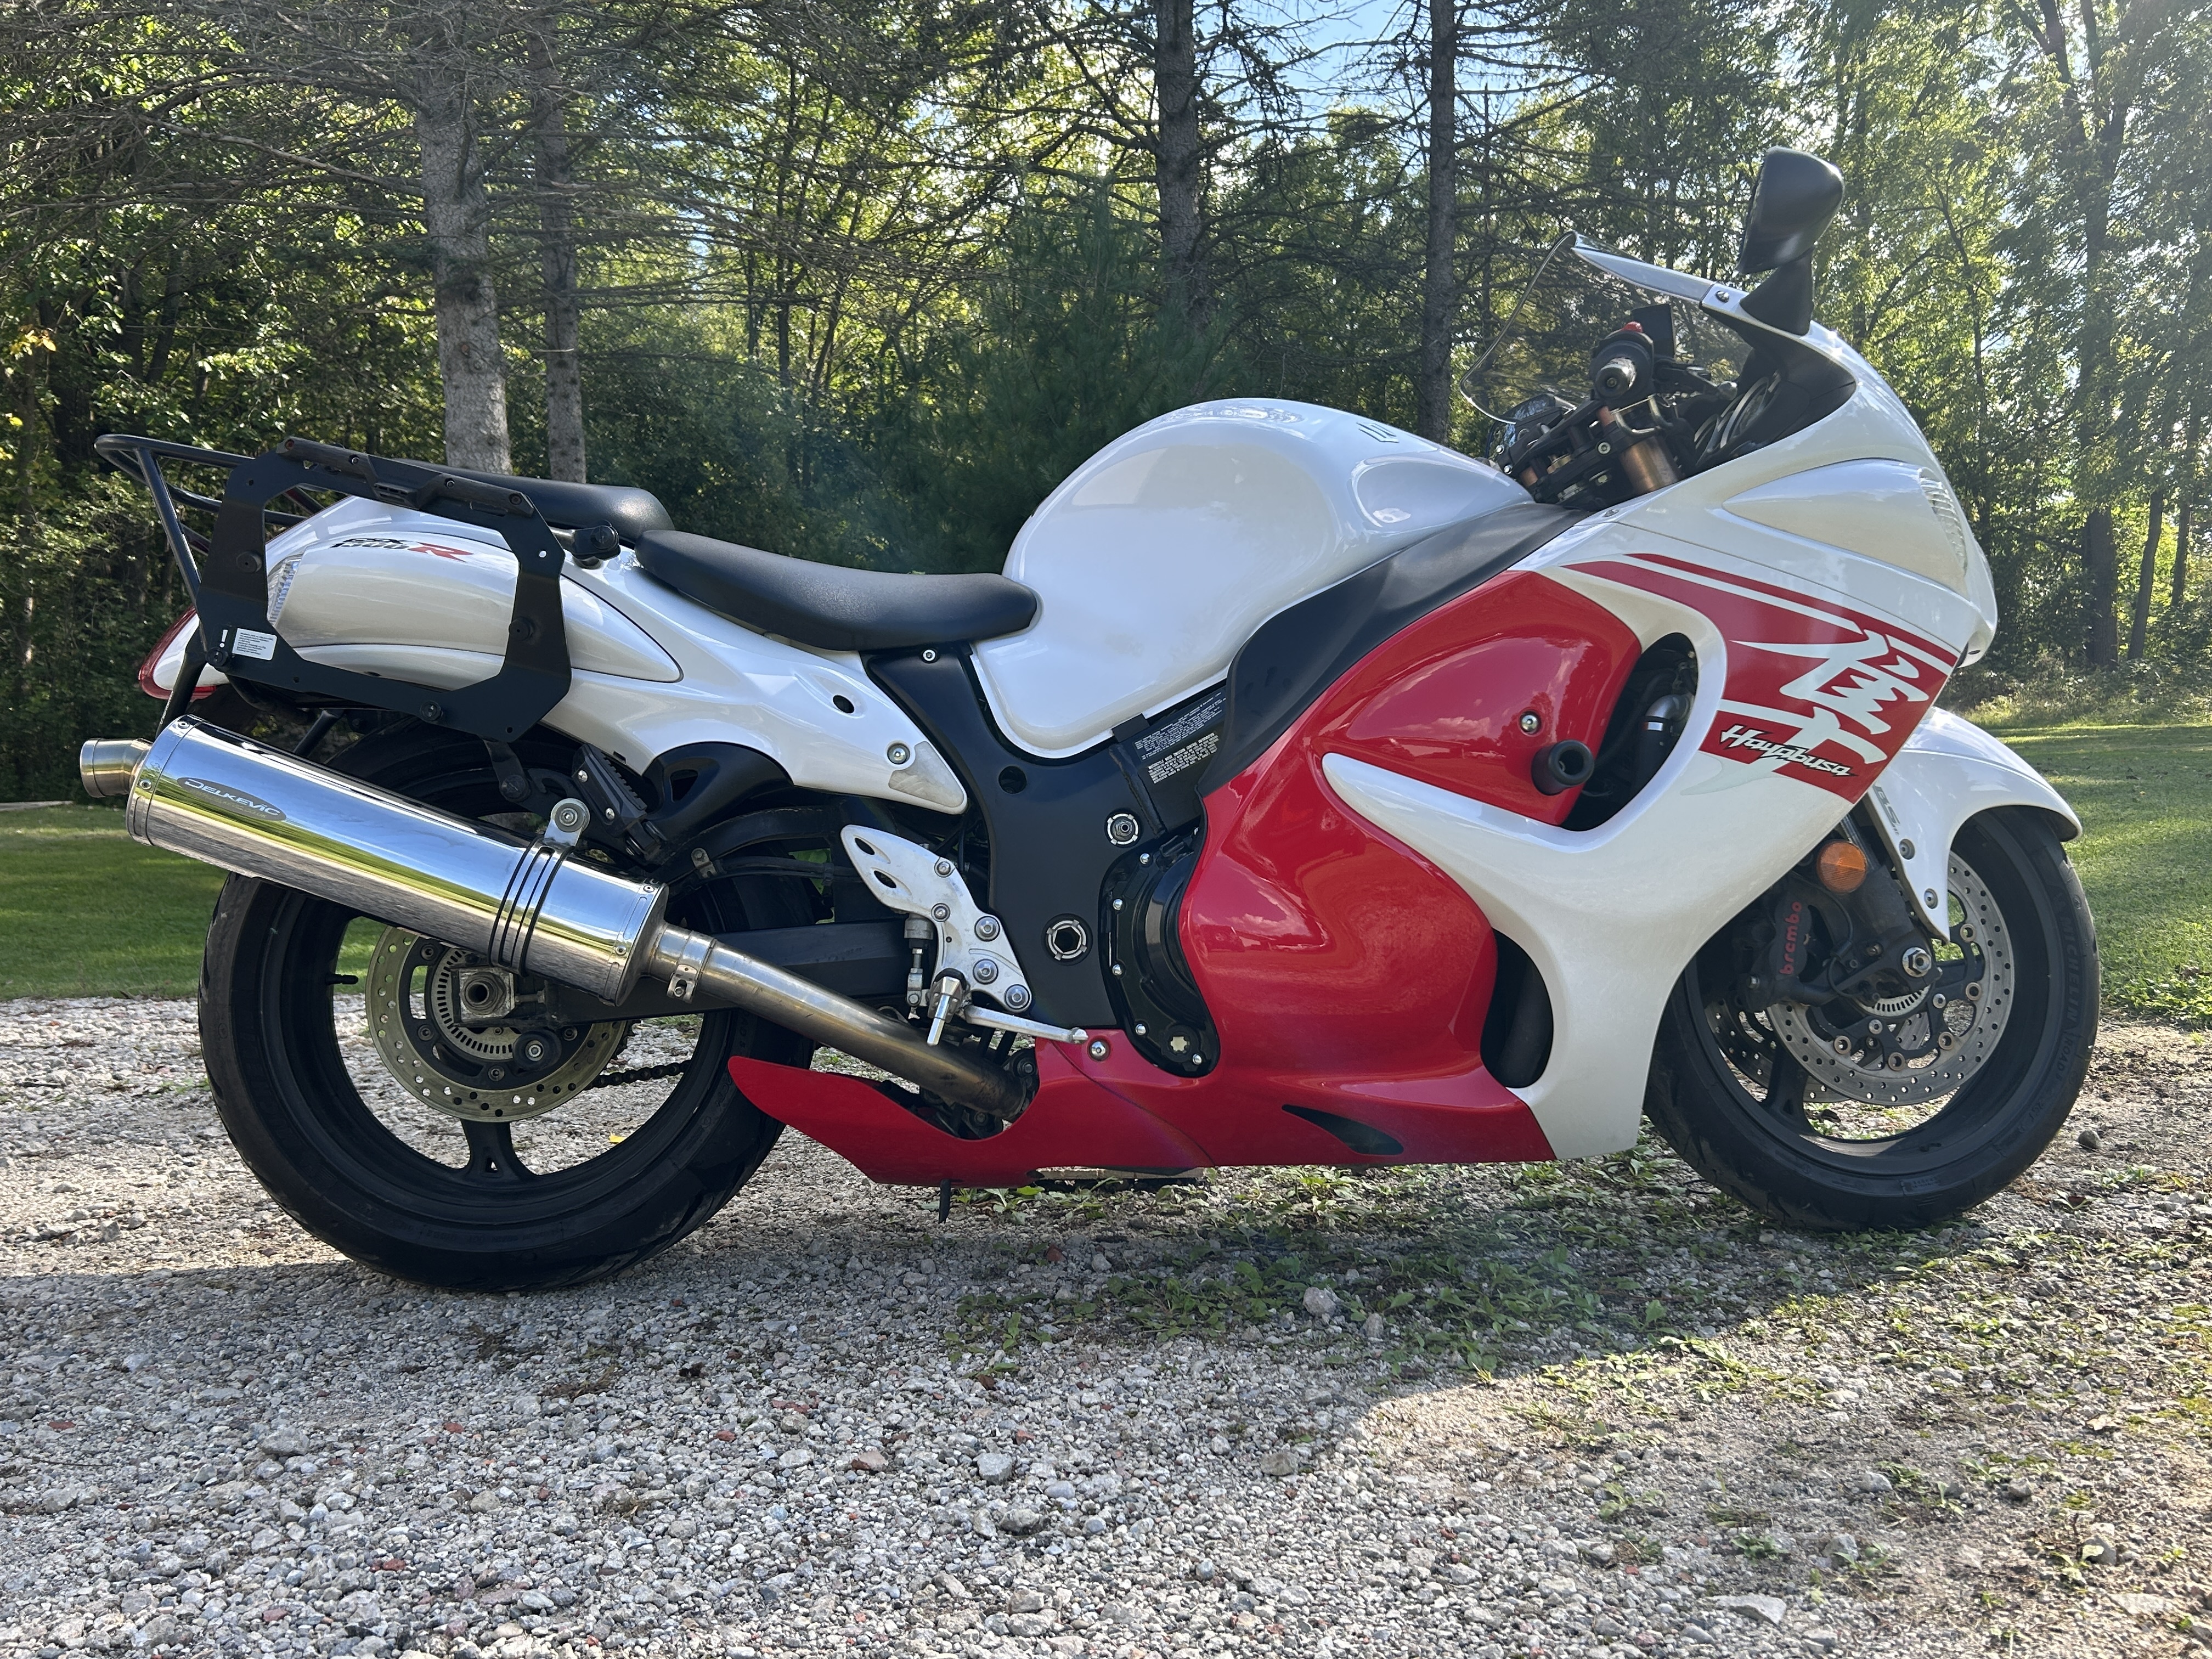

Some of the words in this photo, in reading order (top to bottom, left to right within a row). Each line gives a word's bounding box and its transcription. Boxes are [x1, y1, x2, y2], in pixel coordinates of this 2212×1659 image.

[1719, 724, 1858, 776] Hayabusa
[184, 778, 281, 816] DELKEVIC
[1872, 785, 1900, 828] BS
[1779, 901, 1802, 975] brembo
[2059, 916, 2080, 1022] MICHELIN
